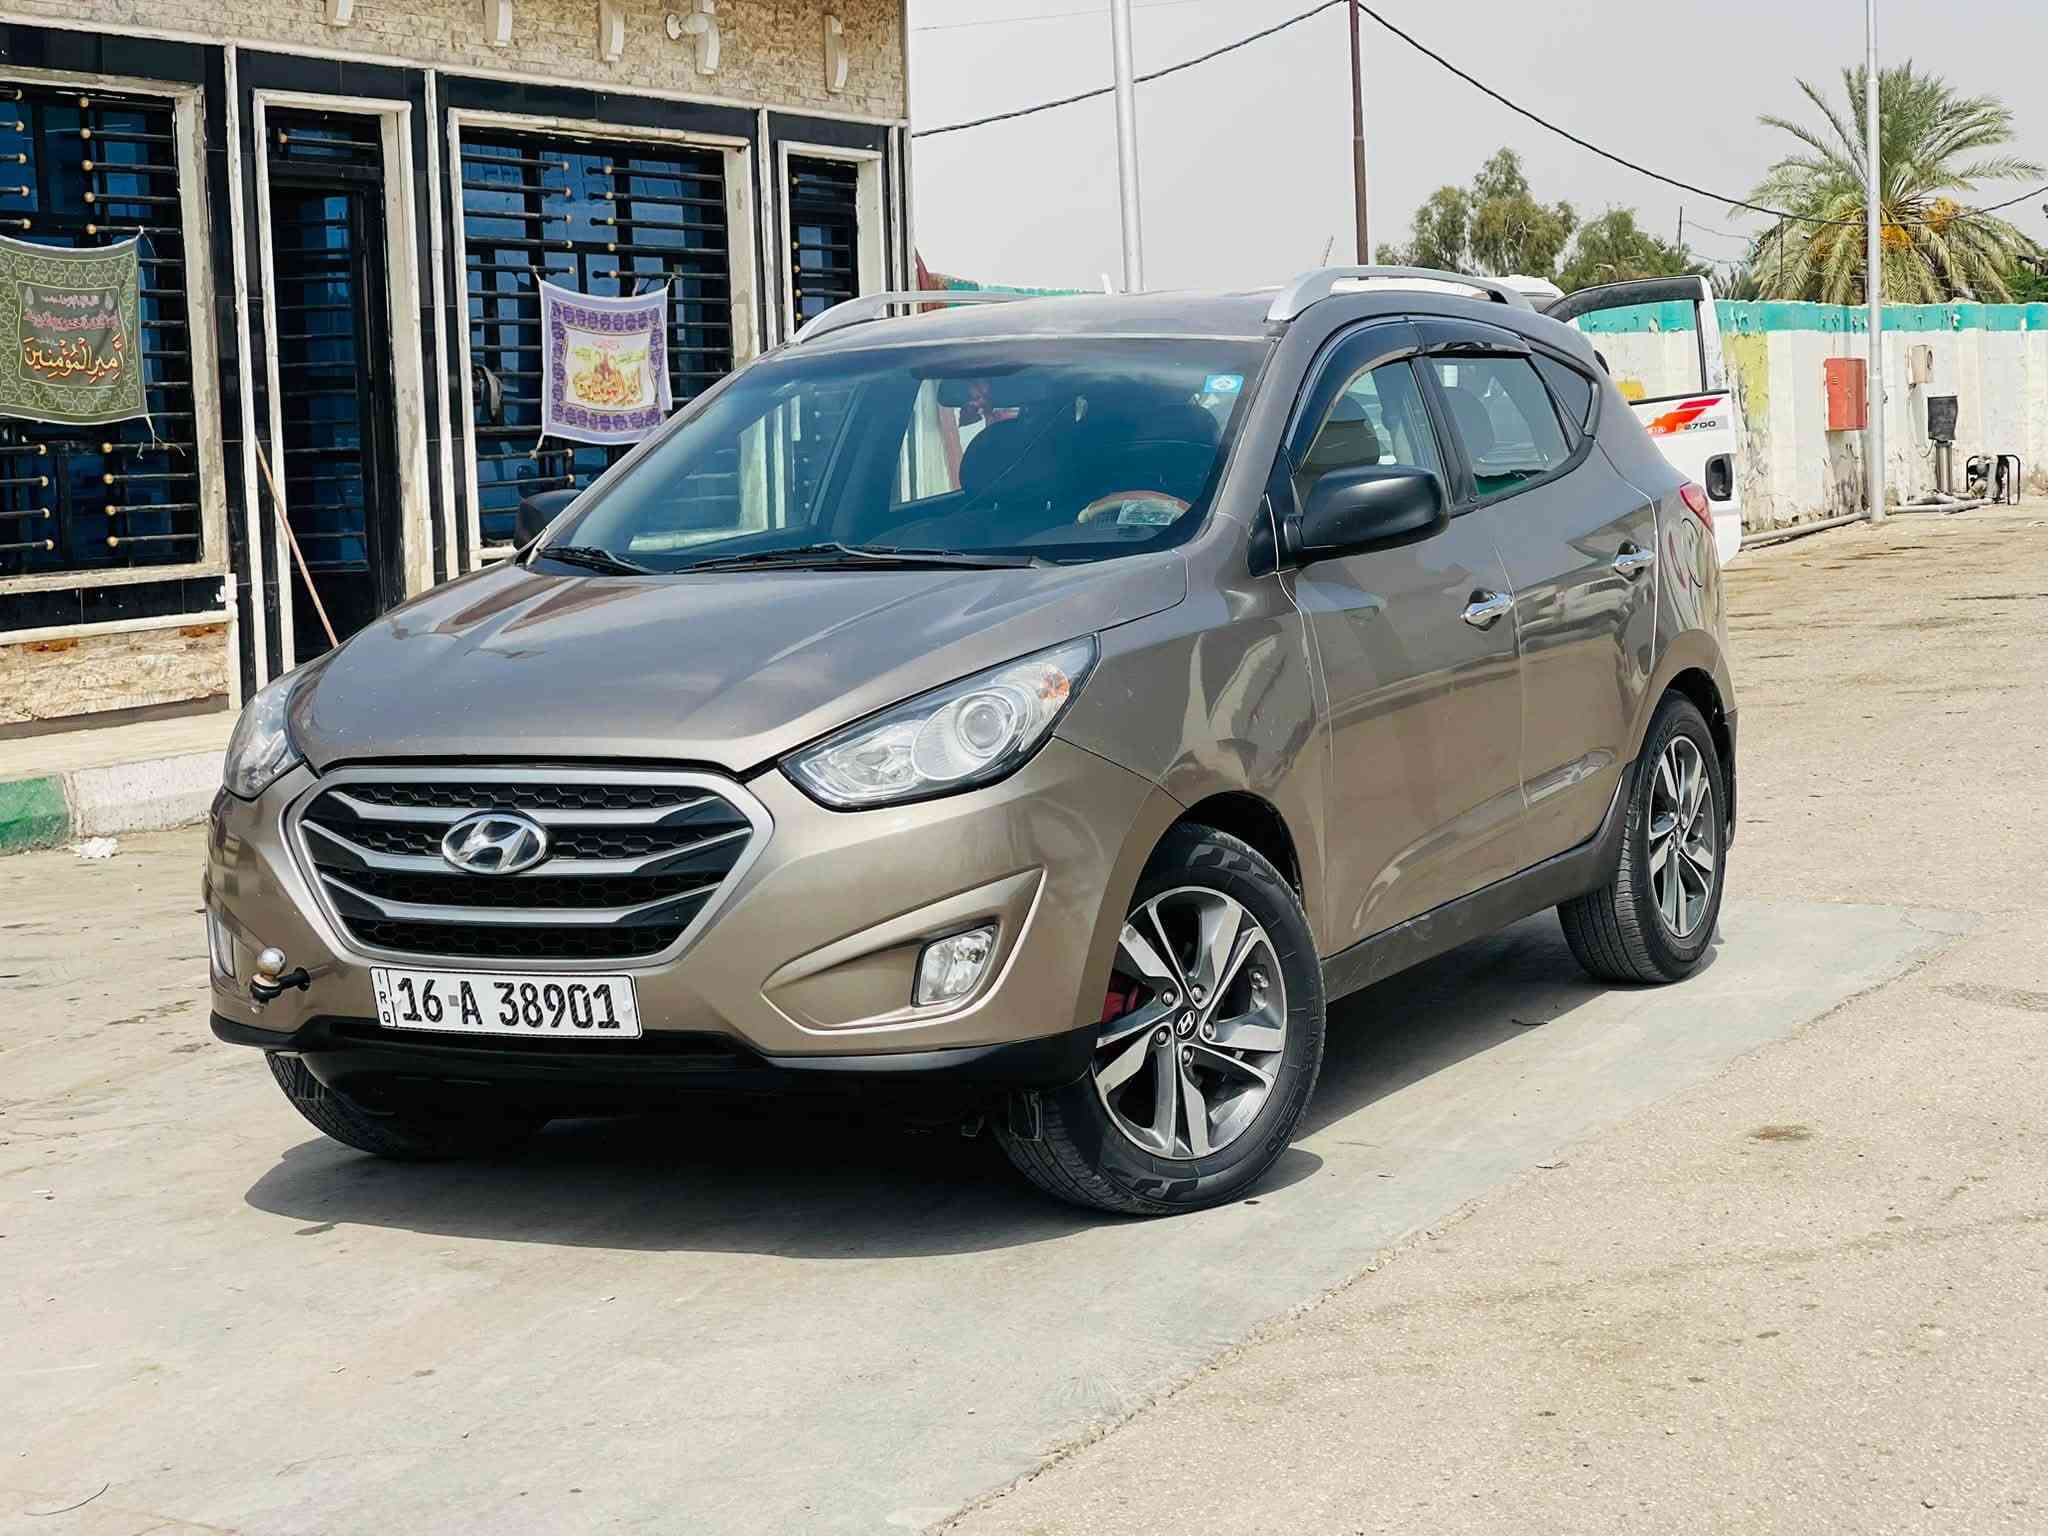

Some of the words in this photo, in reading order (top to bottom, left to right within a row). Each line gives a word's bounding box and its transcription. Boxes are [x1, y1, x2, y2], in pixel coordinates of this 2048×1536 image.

[398, 977, 444, 1022] 16
[459, 980, 483, 1025] A
[493, 981, 621, 1029] 38901
